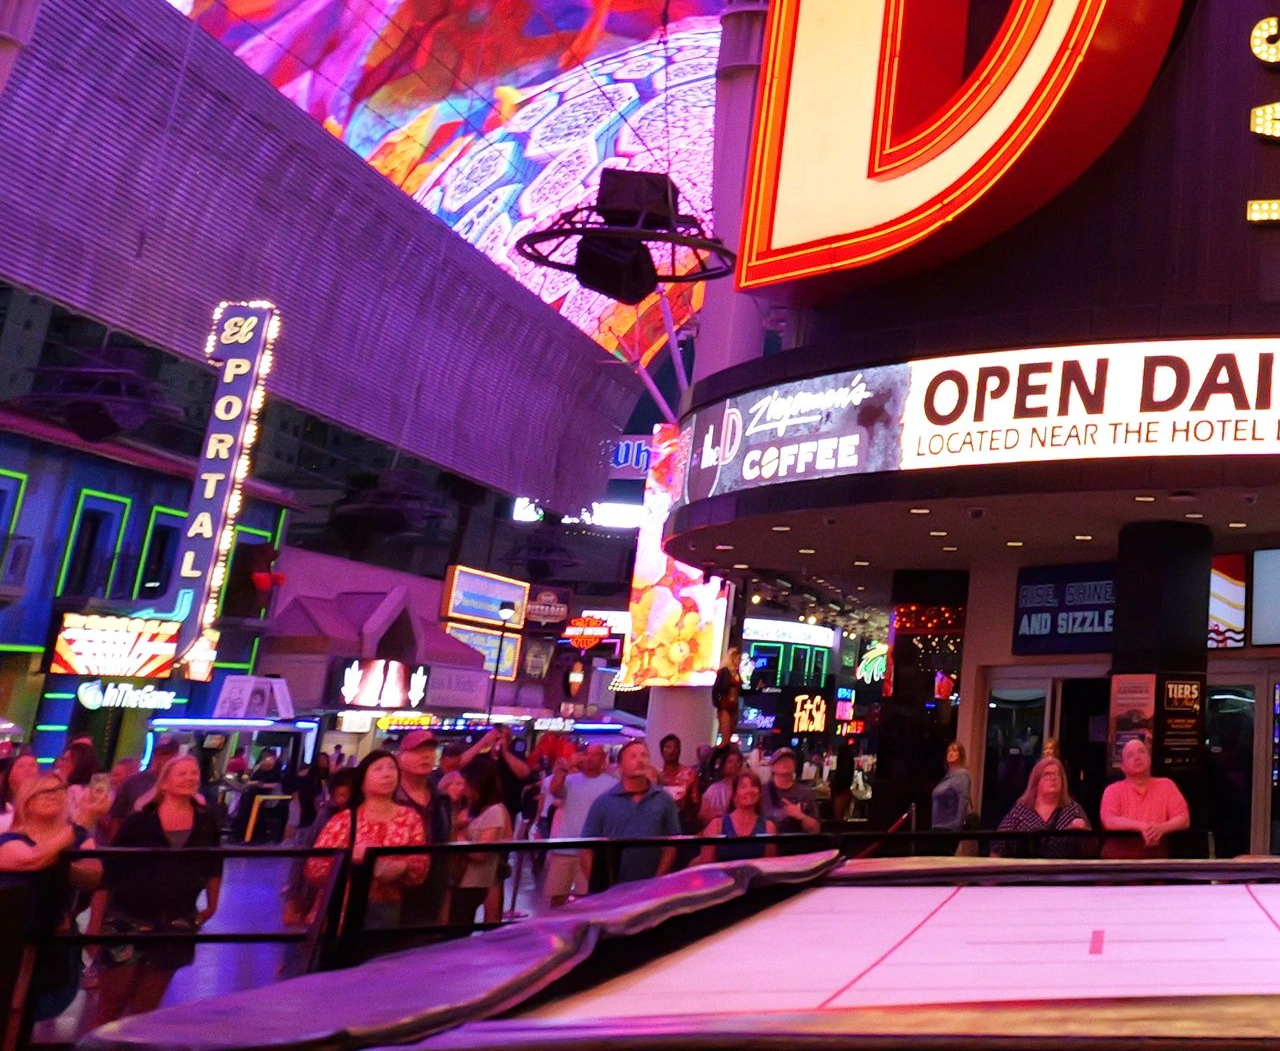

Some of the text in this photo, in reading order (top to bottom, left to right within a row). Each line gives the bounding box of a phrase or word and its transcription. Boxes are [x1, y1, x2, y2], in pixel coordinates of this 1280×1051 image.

[220, 315, 259, 344] El
[924, 357, 1109, 426] OPEN
[916, 427, 1020, 456] LOCATED
[1029, 423, 1097, 448] NEAR
[1109, 421, 1159, 445] THE
[1171, 418, 1263, 443] HOTEL
[180, 358, 251, 578] PORTAL
[742, 433, 860, 481] COFFEE
[1018, 609, 1115, 636] AND SIZZLE
[1167, 683, 1199, 699] TIERS
